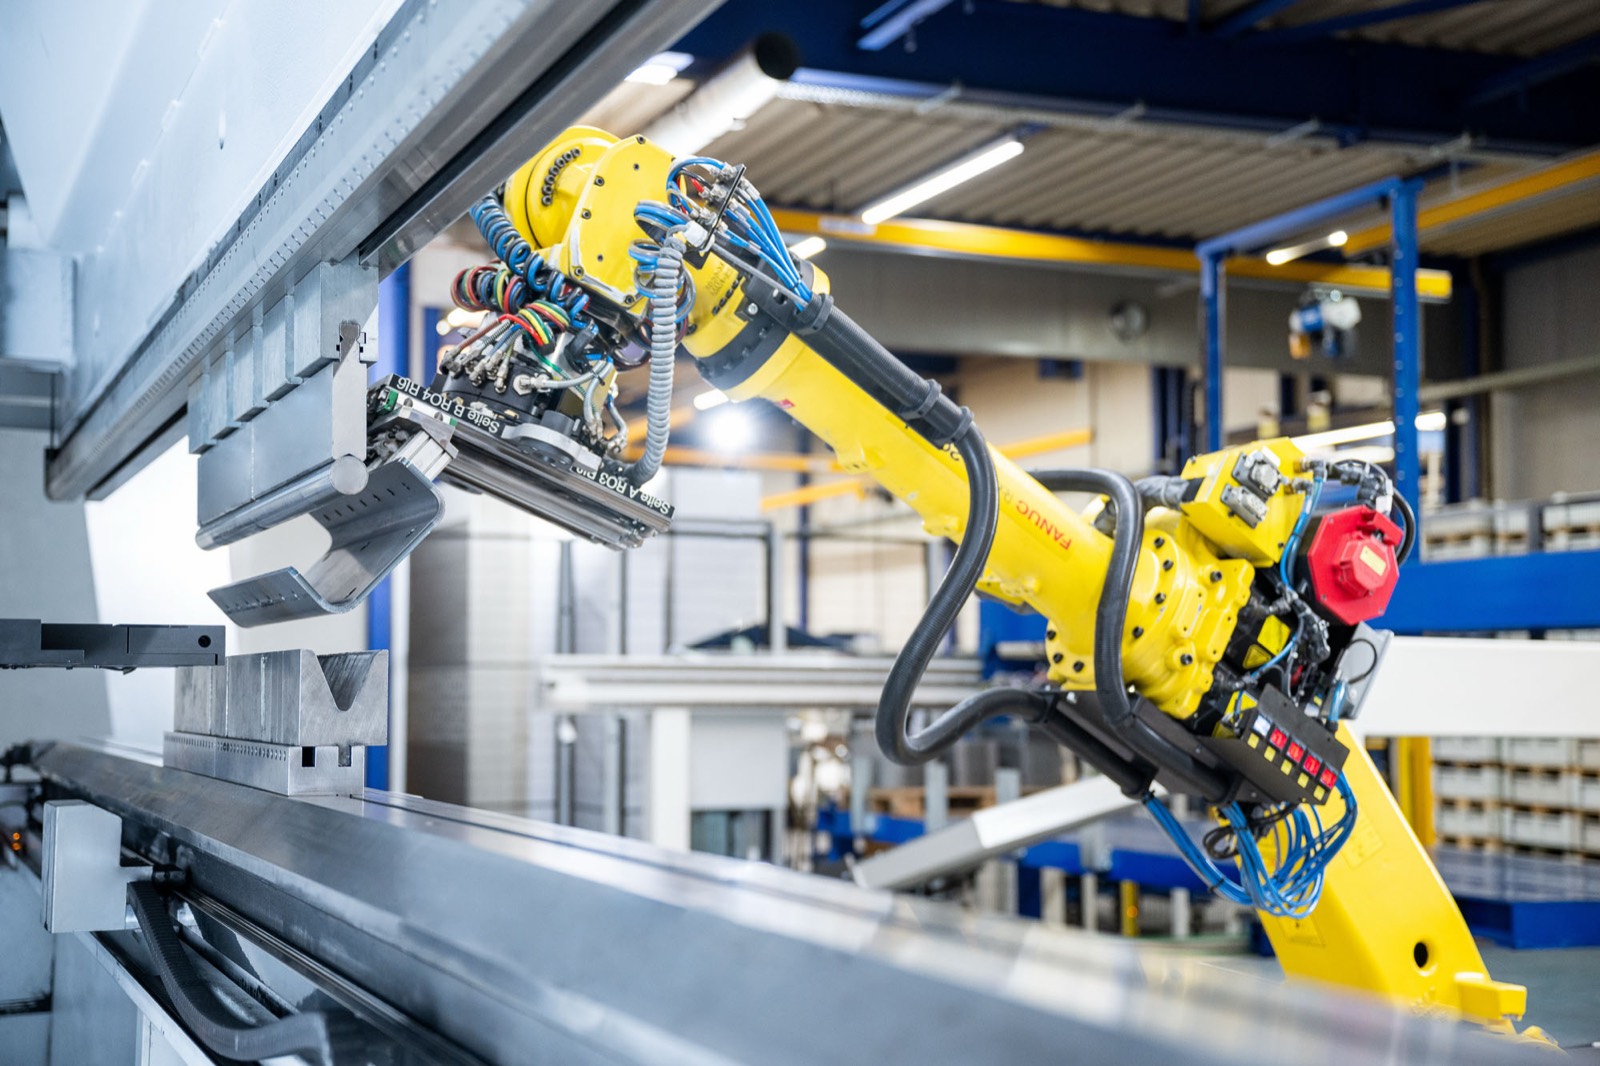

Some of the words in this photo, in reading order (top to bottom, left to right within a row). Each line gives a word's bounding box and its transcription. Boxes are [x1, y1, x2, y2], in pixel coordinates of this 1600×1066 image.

[453, 404, 464, 418] B
[468, 410, 500, 433] Seite
[629, 486, 640, 499] A
[640, 492, 671, 515] Seite
[1016, 500, 1073, 551] FANUC
